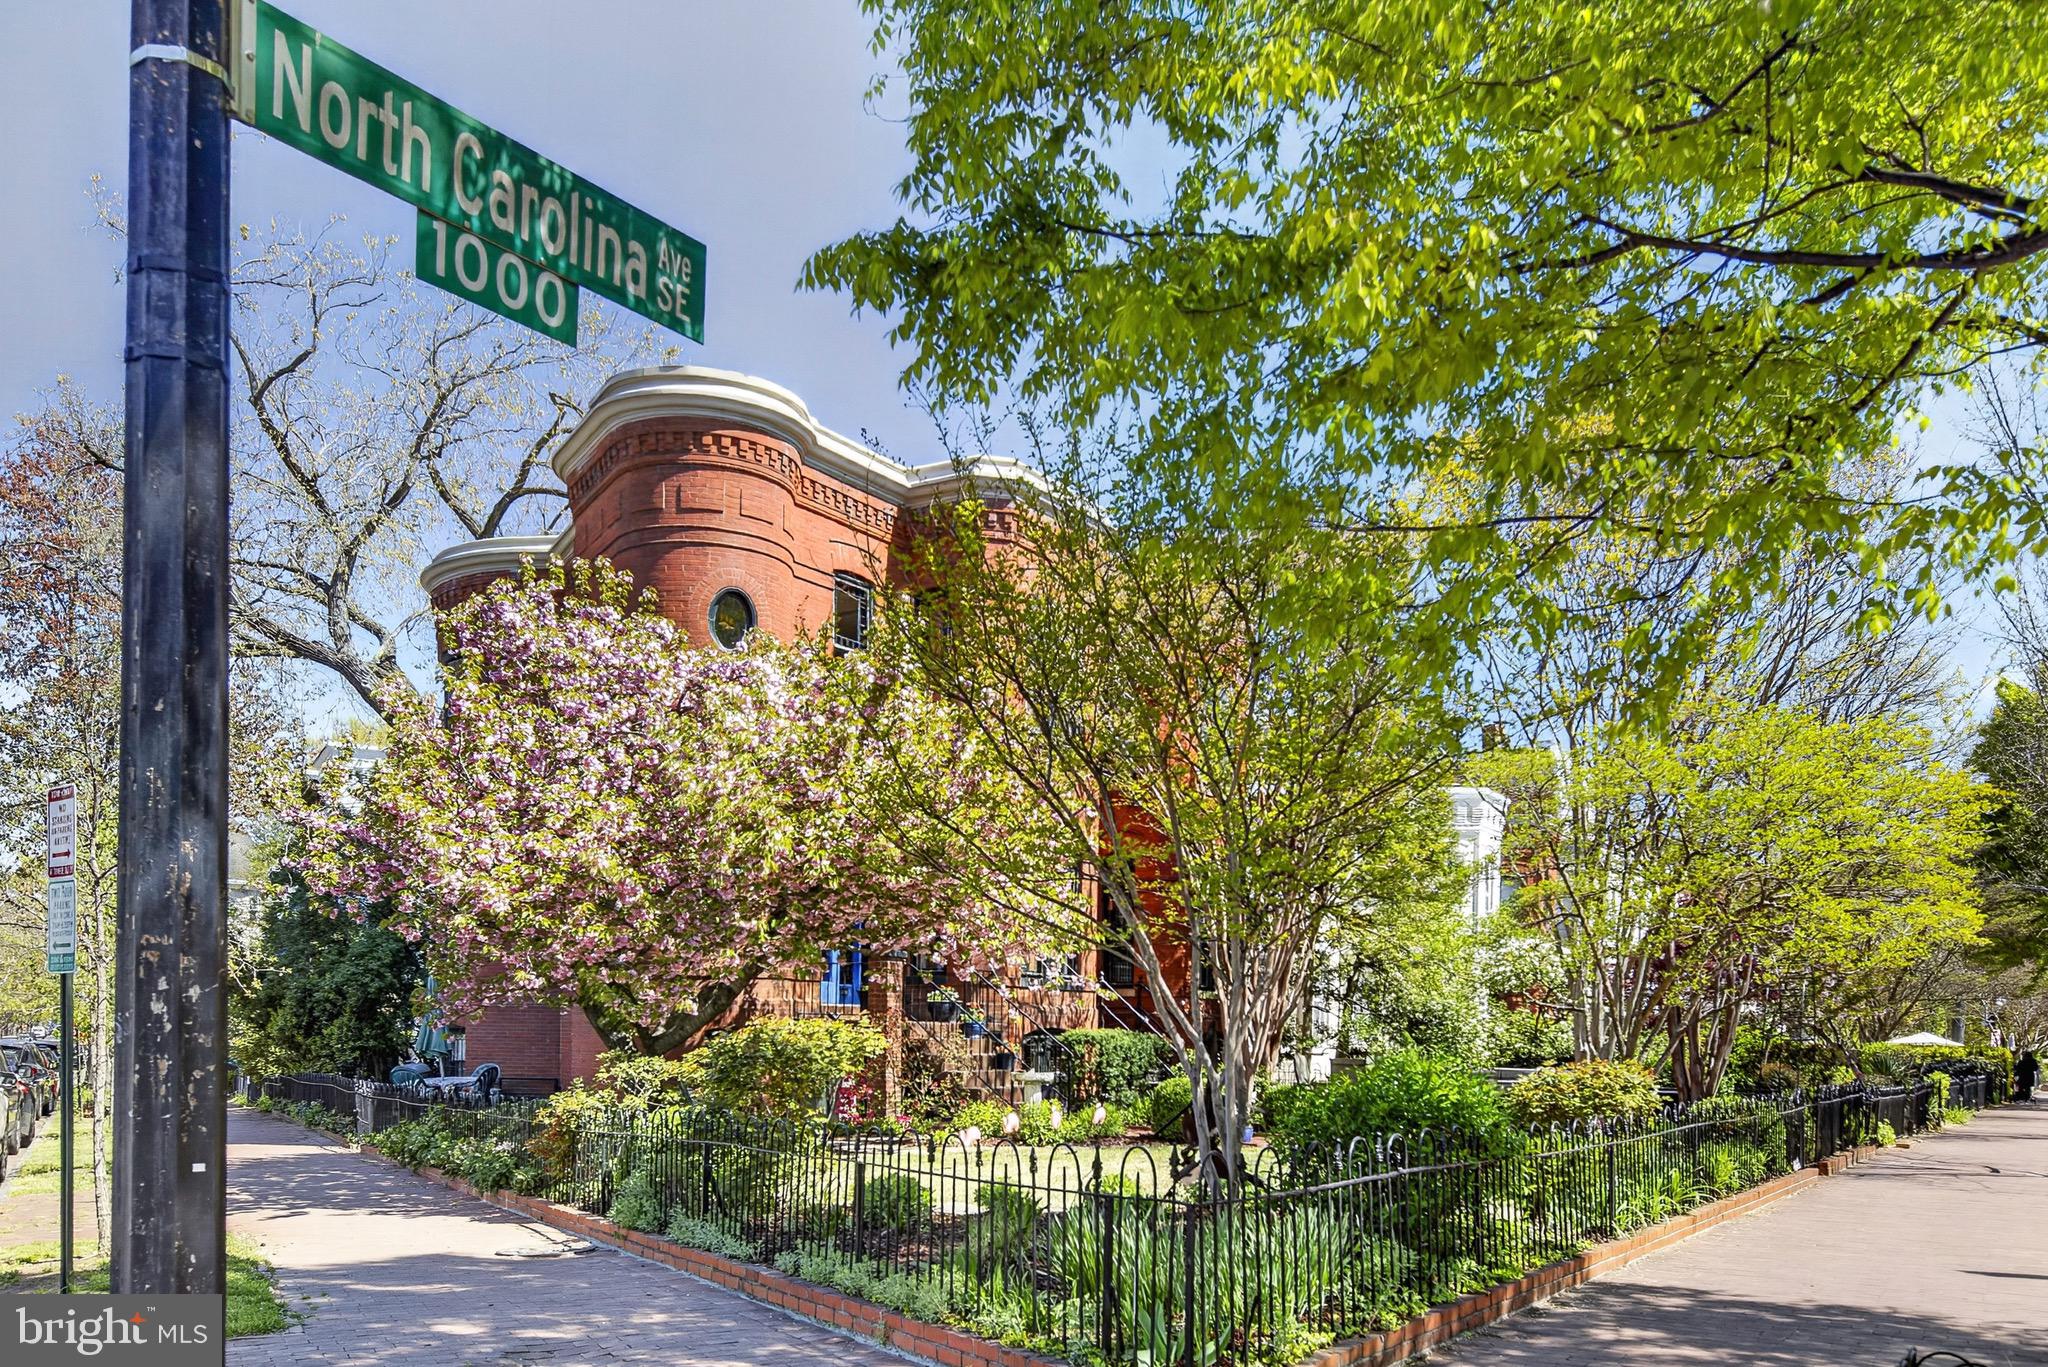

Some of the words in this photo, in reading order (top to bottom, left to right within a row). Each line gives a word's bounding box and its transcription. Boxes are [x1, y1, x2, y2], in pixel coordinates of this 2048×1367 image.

[272, 28, 432, 193] North
[453, 131, 647, 301] Carolina
[657, 236, 692, 285] Ave
[432, 219, 565, 328] 1000
[656, 278, 691, 323] SE
